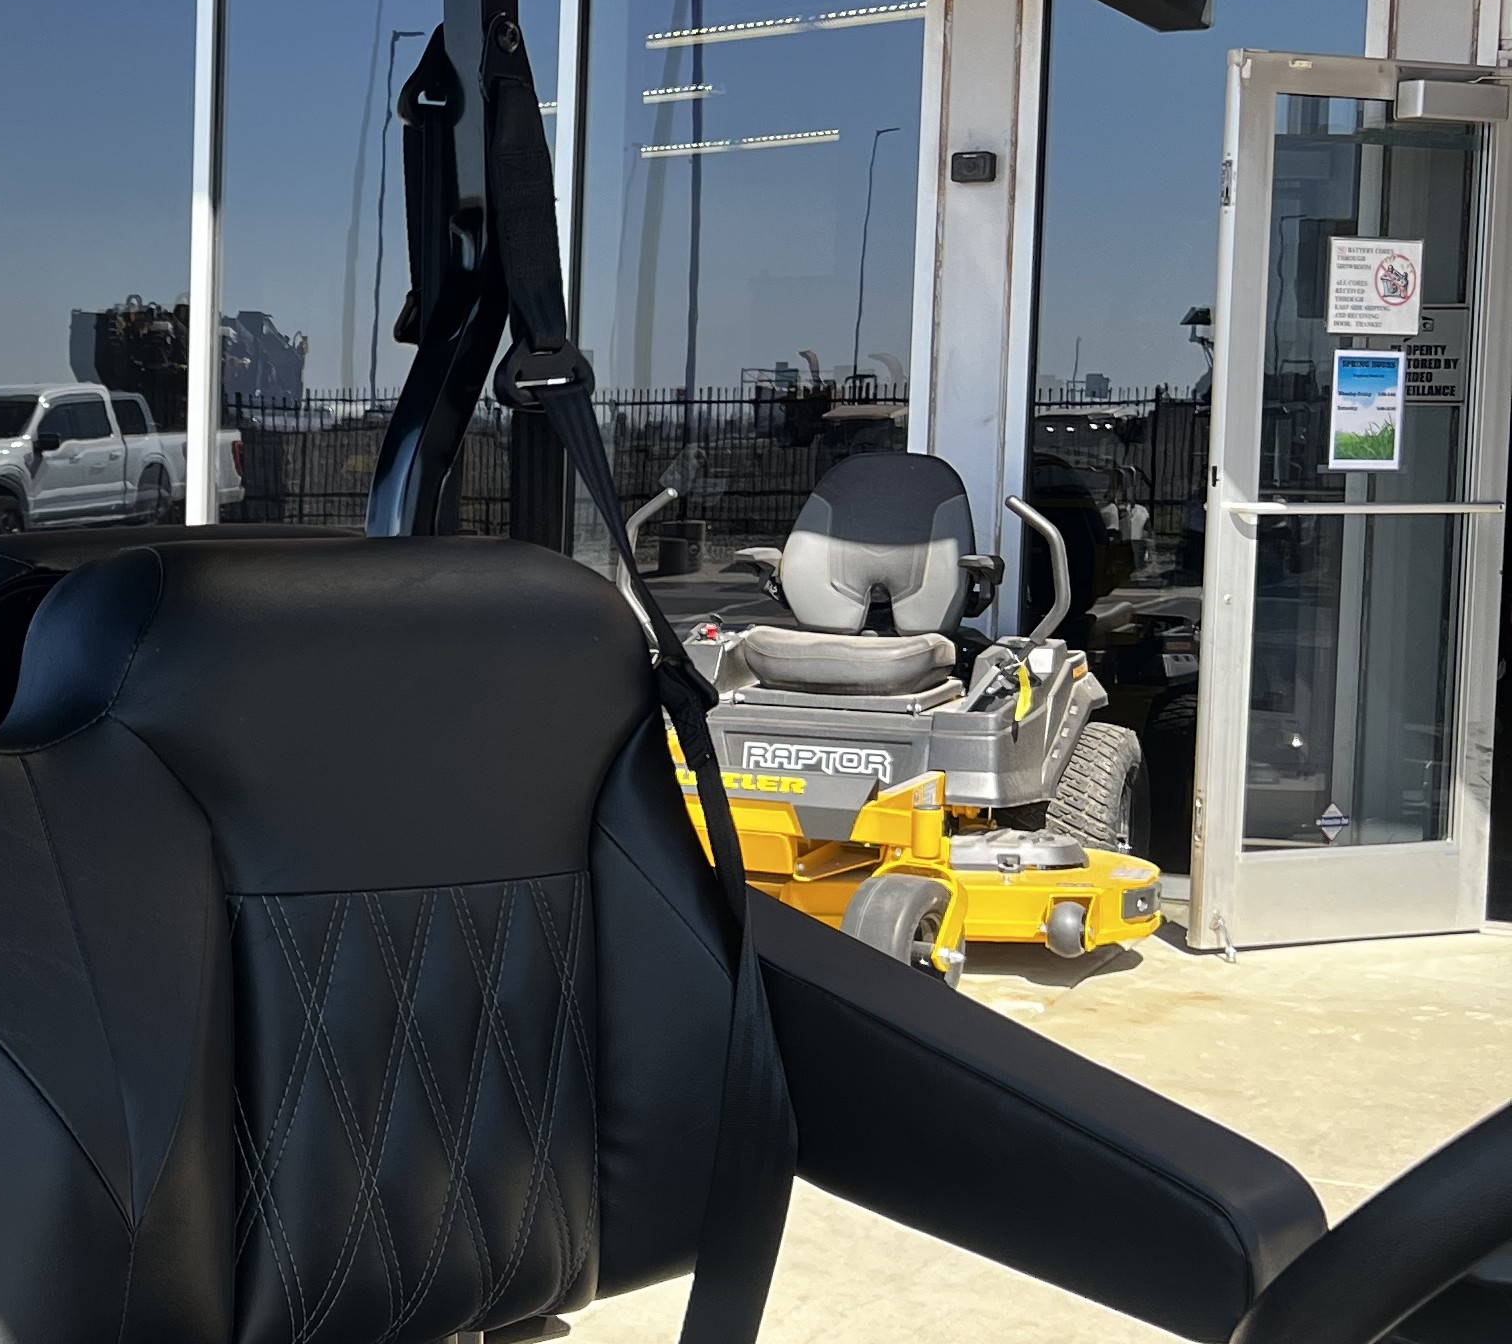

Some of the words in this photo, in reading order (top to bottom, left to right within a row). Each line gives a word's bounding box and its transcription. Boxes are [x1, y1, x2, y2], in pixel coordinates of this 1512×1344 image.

[1406, 358, 1441, 369] TORED
[1443, 358, 1459, 370] BY
[742, 741, 893, 784] RAPTOR
